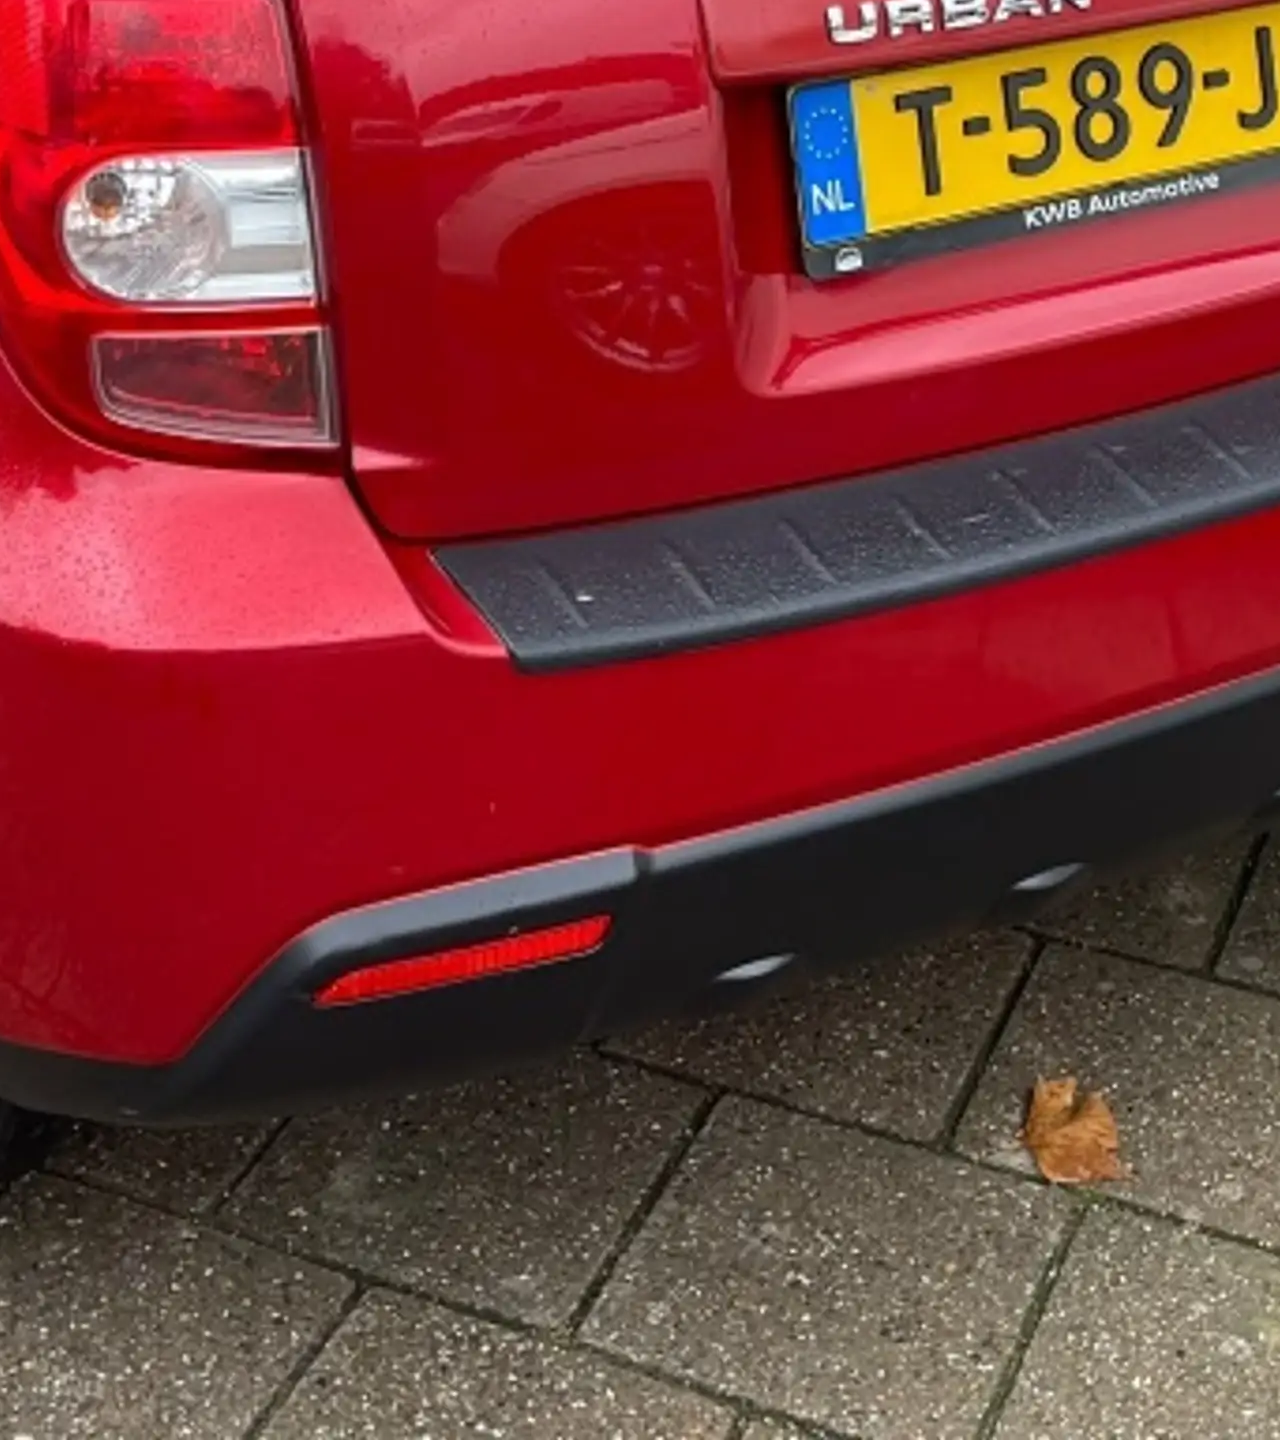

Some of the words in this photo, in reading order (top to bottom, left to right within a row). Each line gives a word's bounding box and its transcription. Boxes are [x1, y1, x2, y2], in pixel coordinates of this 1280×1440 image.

[810, 183, 856, 216] NL
[1023, 198, 1084, 231] KWB
[1086, 171, 1221, 216] Automotive
